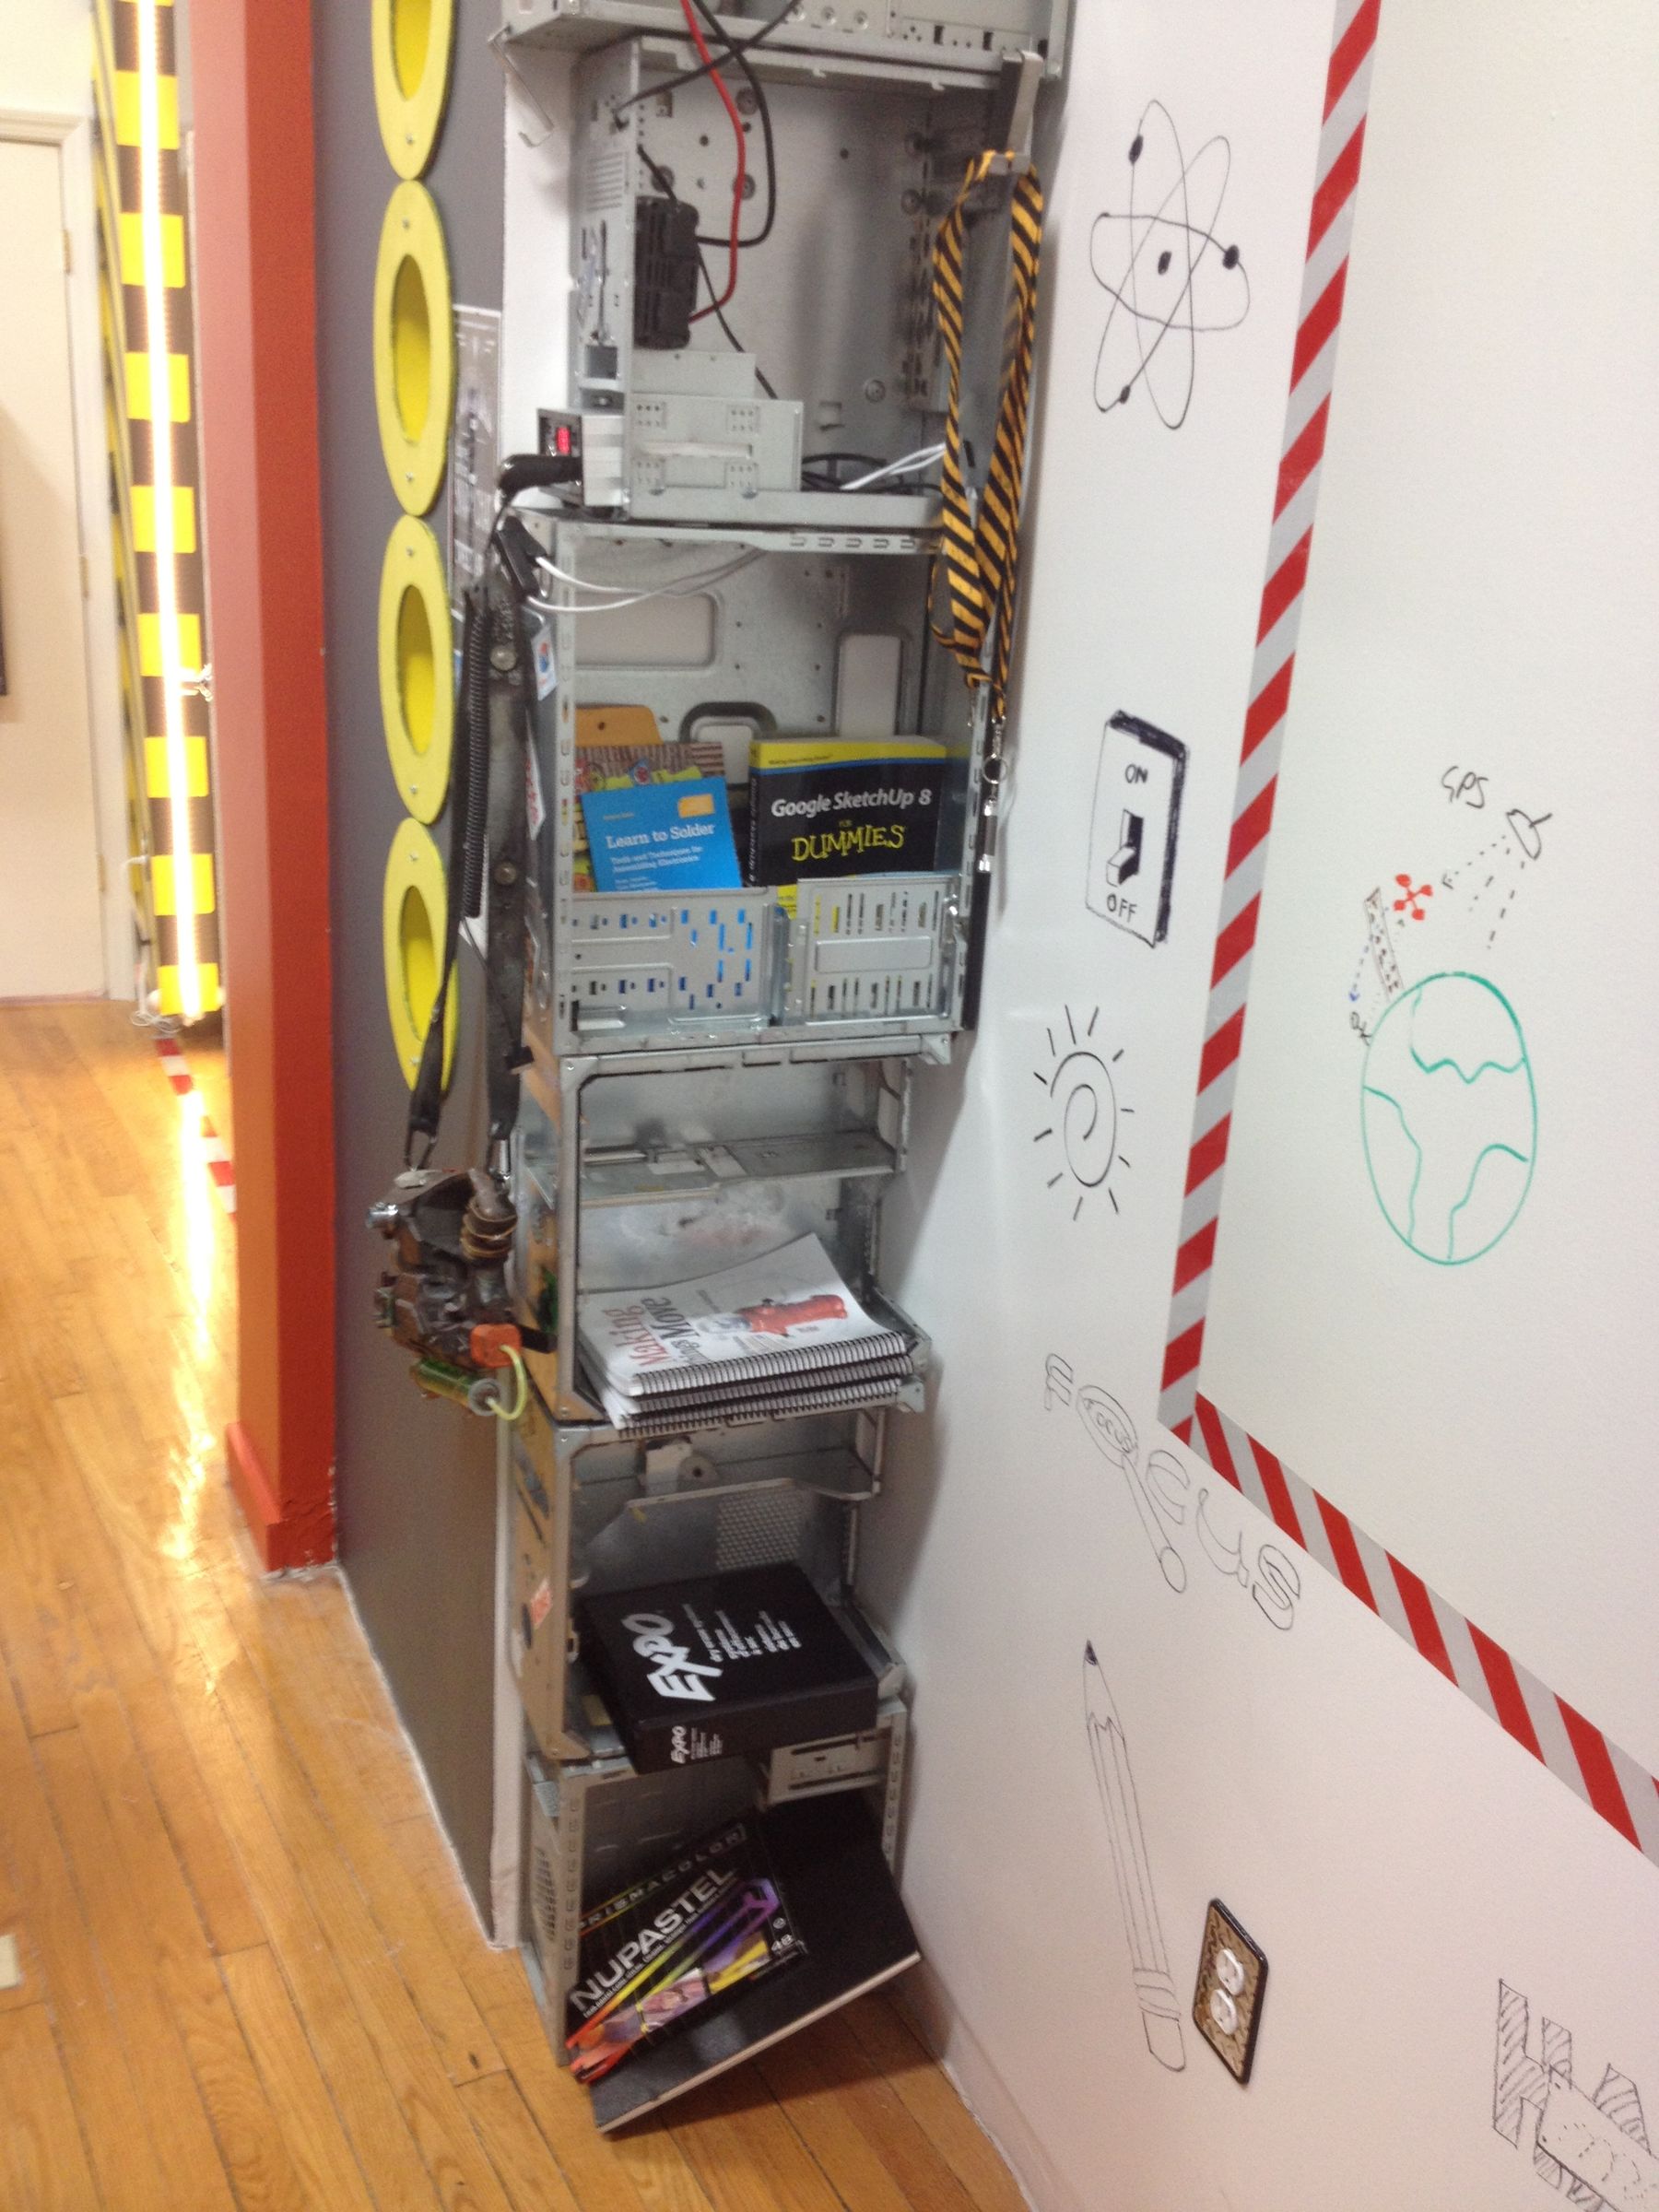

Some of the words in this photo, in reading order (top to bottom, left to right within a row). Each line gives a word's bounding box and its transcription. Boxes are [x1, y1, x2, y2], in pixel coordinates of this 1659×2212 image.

[1124, 762, 1148, 785] ON
[771, 794, 832, 818] Google
[832, 788, 915, 810] SketchUp
[918, 788, 933, 806] 8
[606, 832, 651, 850] Learn
[652, 830, 669, 842] to
[669, 823, 716, 840] Solder
[791, 824, 906, 862] DUMMIES
[1106, 893, 1138, 924] OFF
[601, 1303, 672, 1368] Making
[641, 1295, 701, 1341] Move
[621, 1613, 724, 1701] EXPO
[570, 1866, 735, 2012] NUPASTEL
